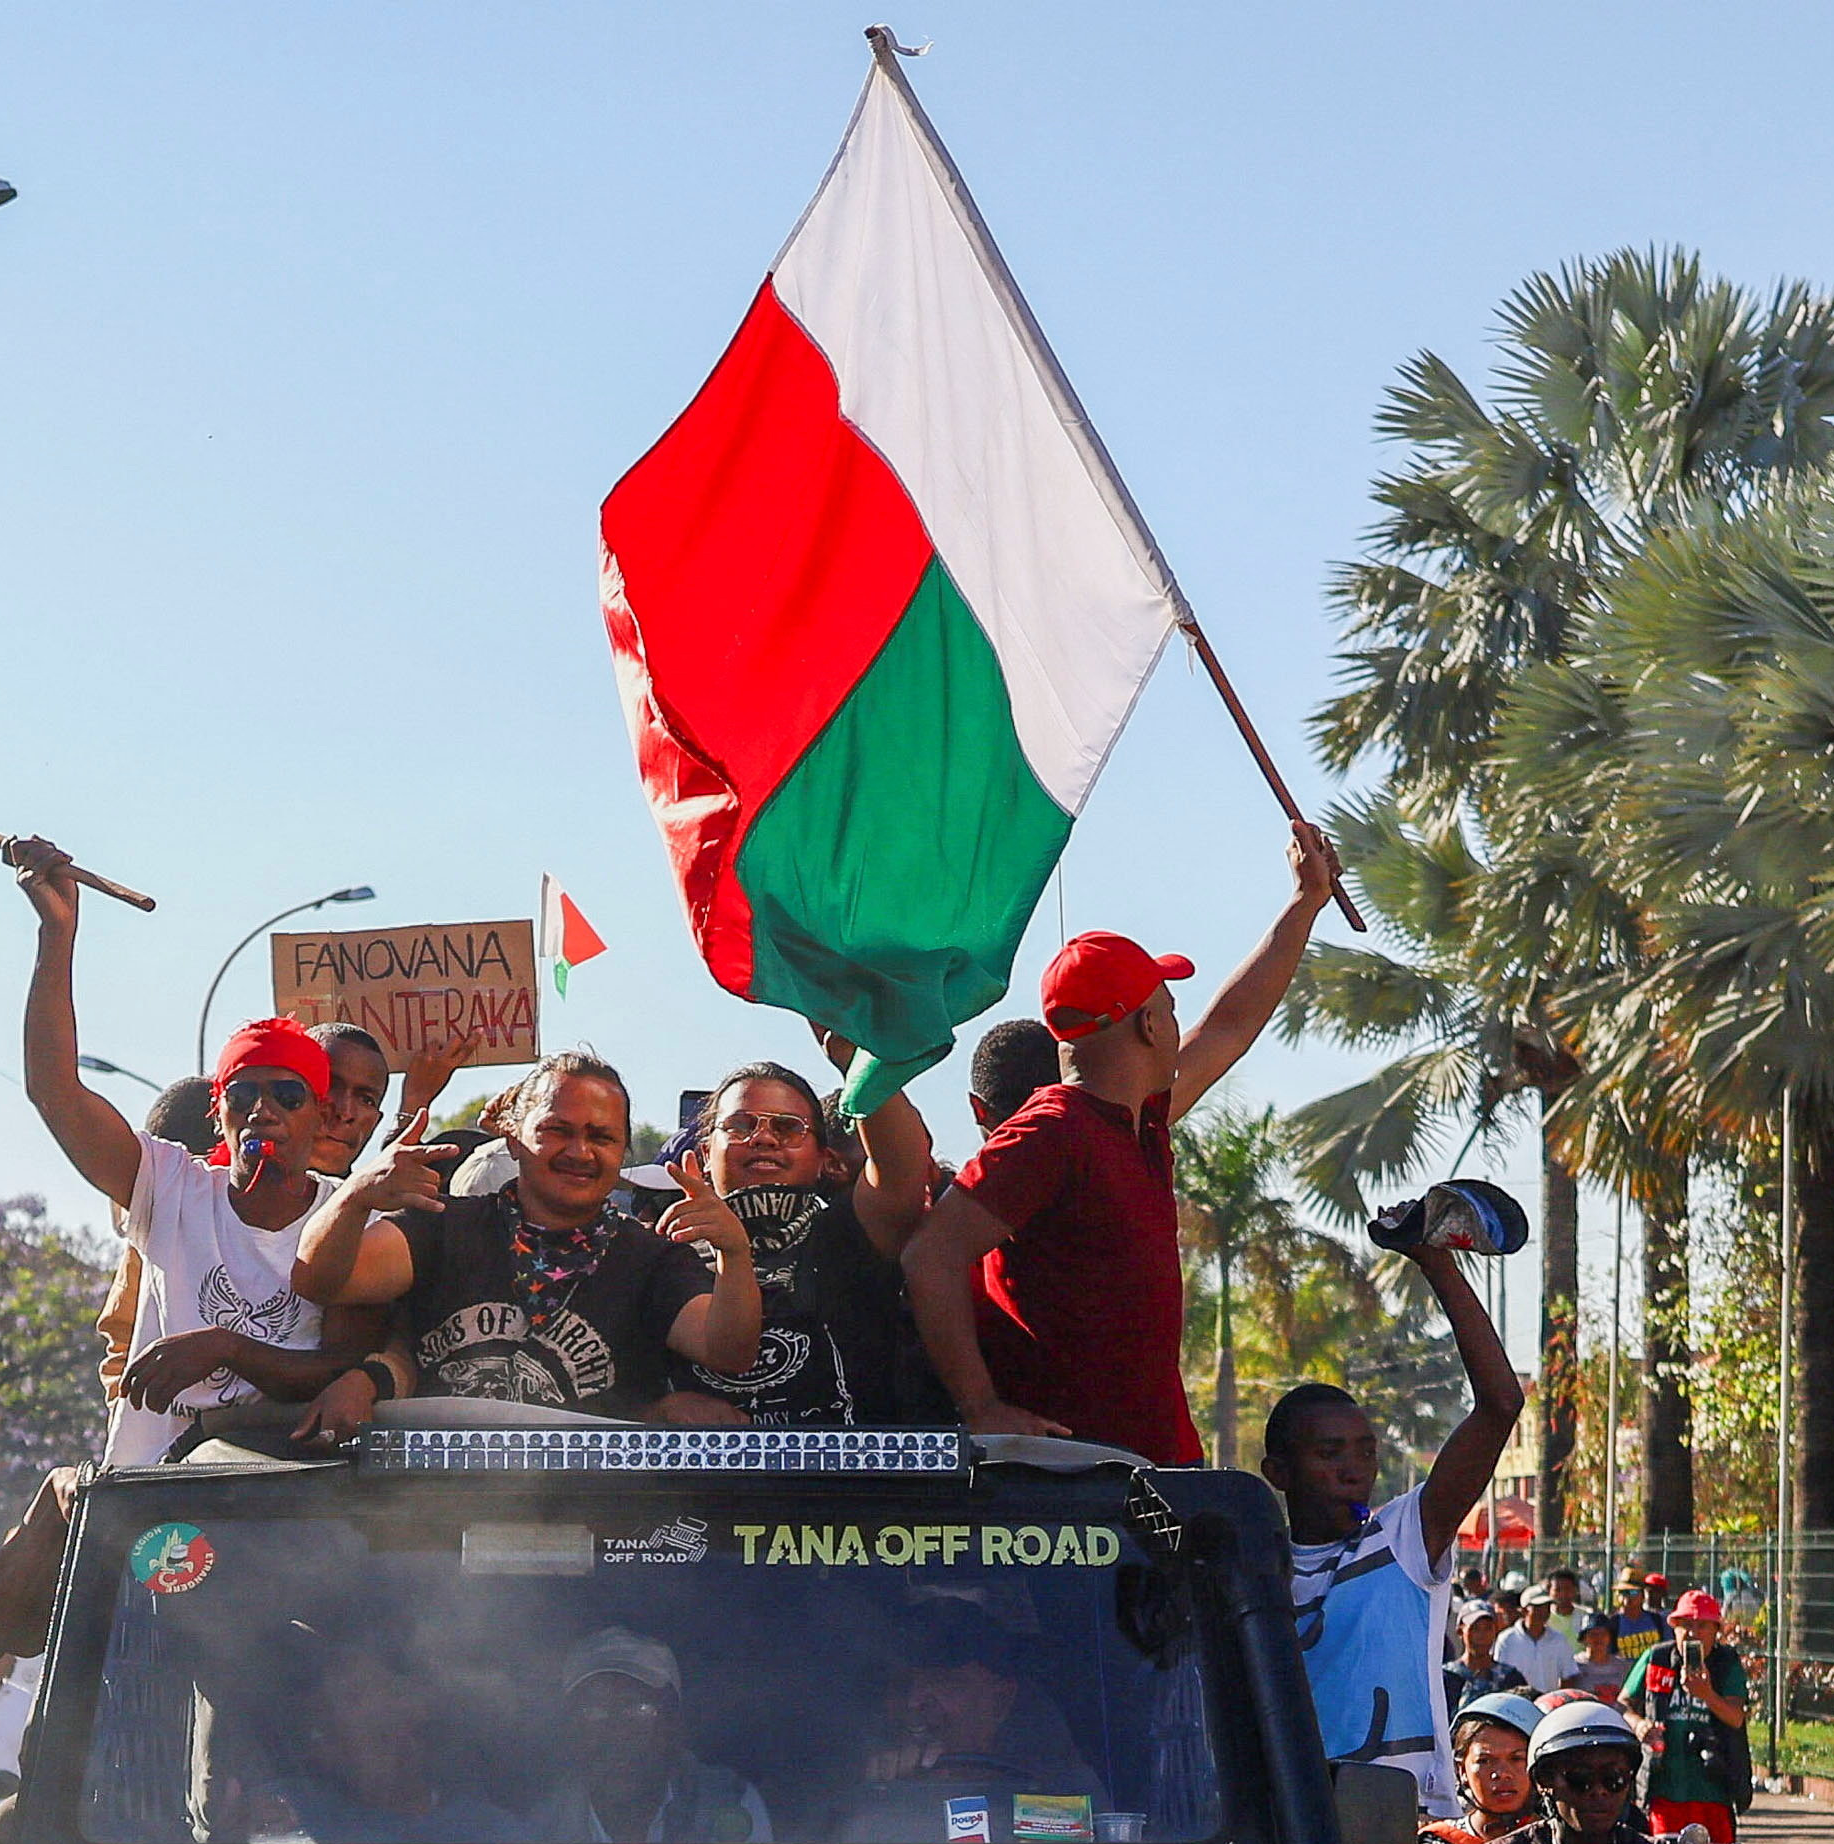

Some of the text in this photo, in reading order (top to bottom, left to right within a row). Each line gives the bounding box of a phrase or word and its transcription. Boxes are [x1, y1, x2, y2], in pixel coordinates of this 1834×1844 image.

[295, 930, 512, 987] FANOVANA
[476, 1306, 516, 1336] OF
[132, 1526, 163, 1556] LEGION
[603, 1538, 650, 1550] TANA
[733, 1525, 1121, 1567] TANA OFF ROAD
[603, 1553, 689, 1563] OFF ROAD
